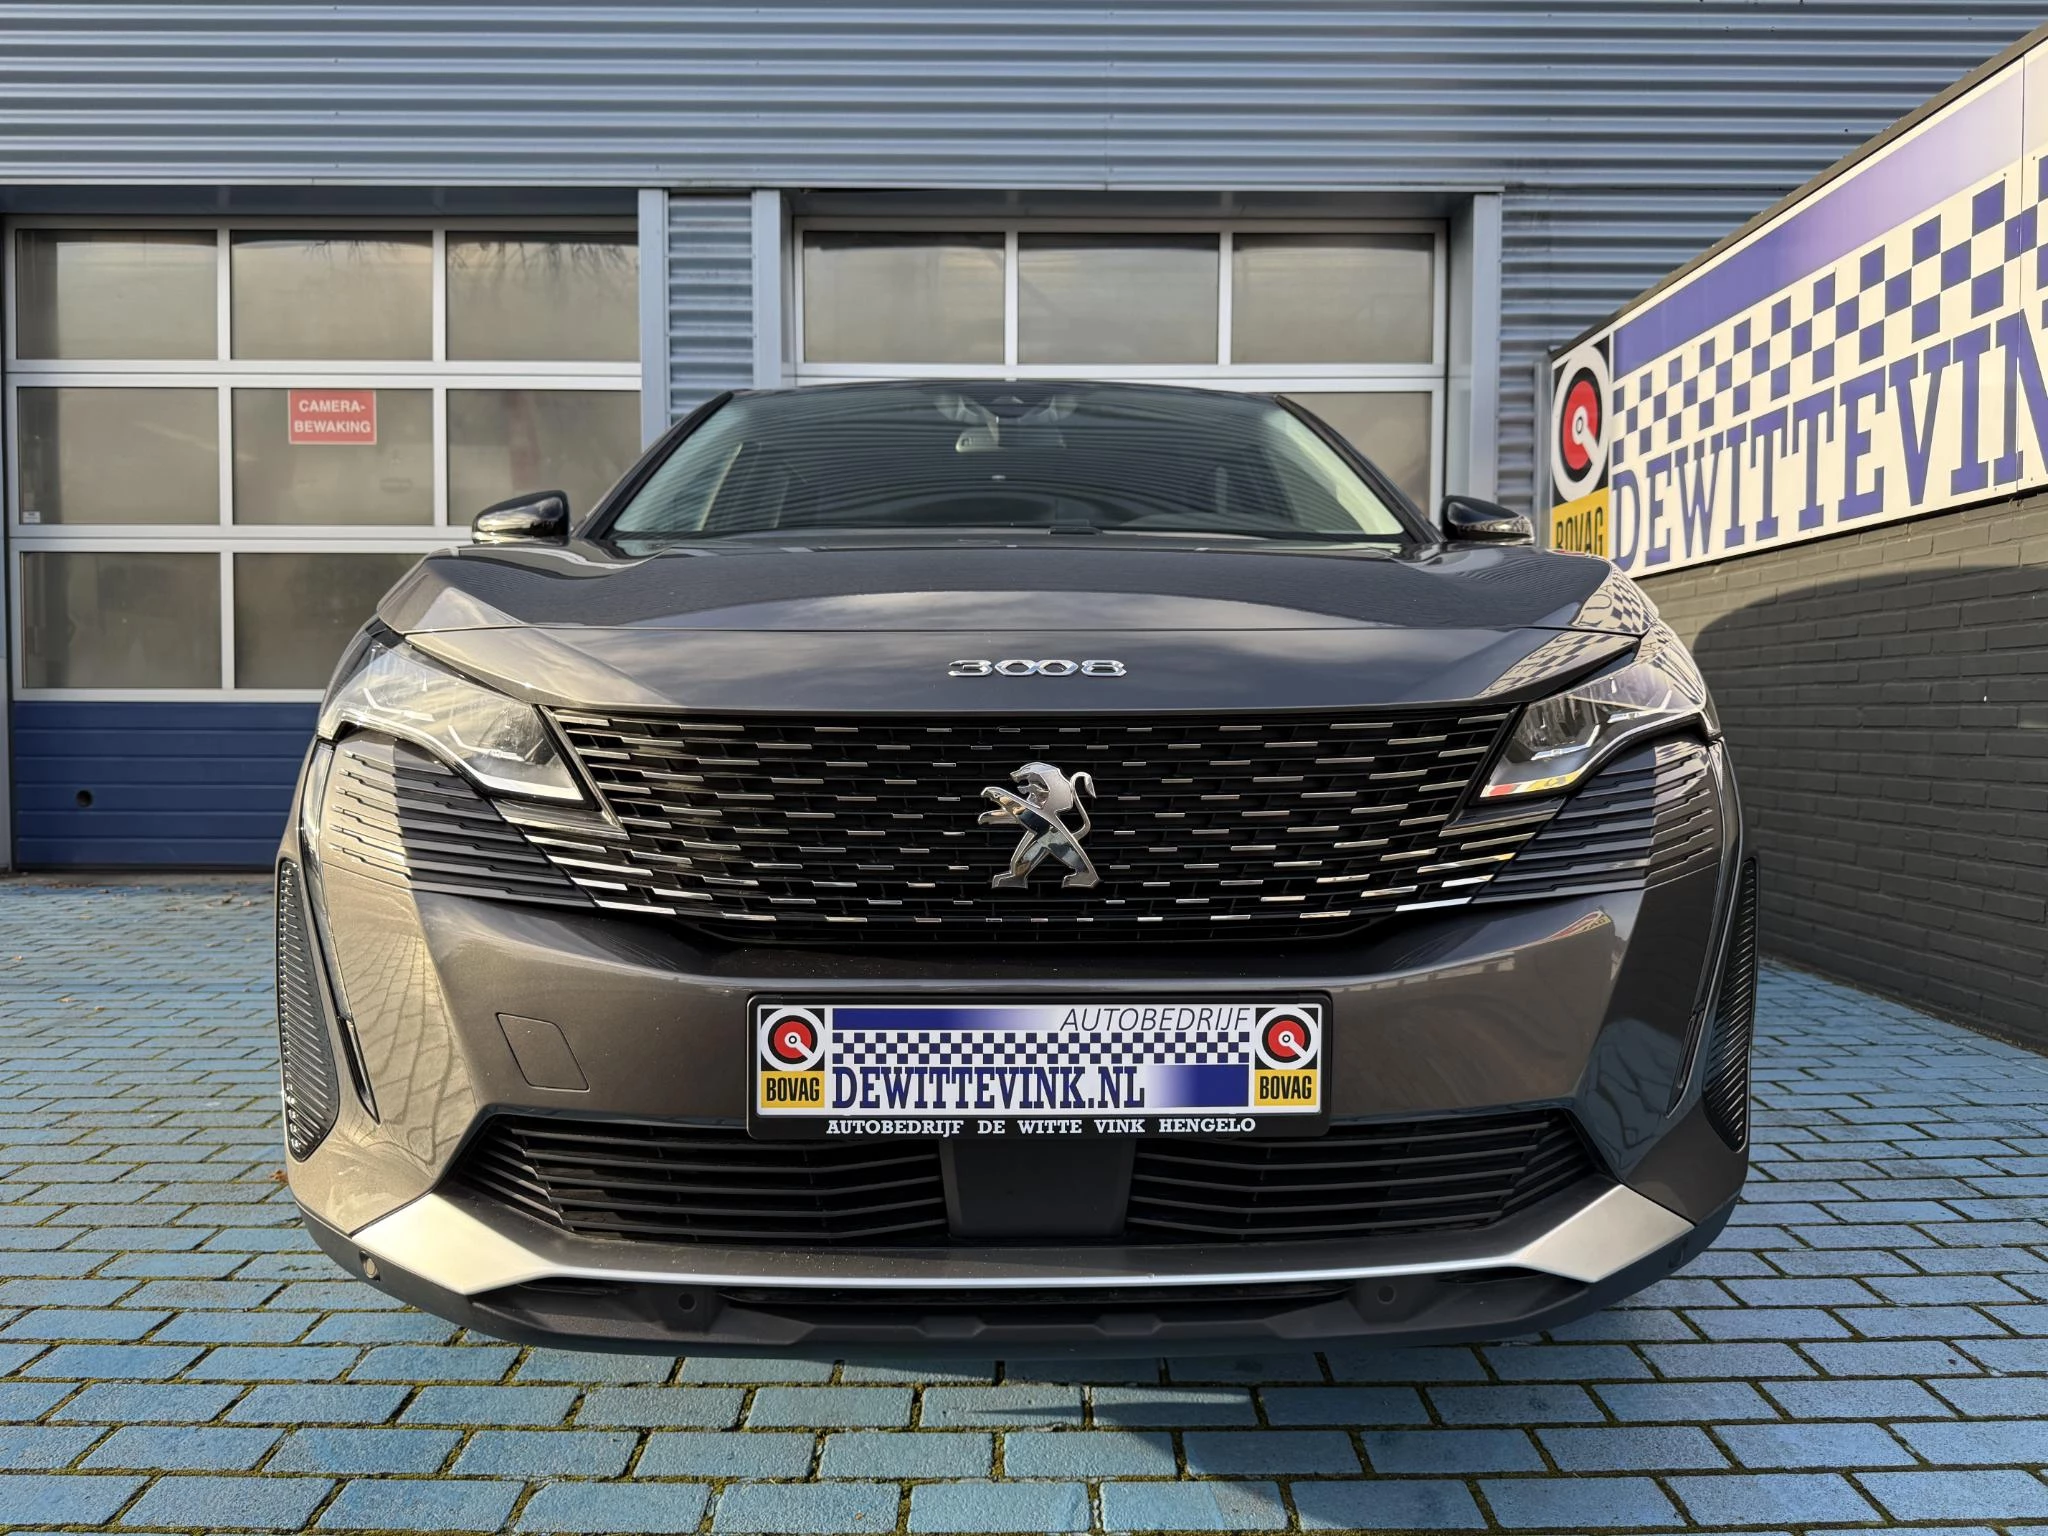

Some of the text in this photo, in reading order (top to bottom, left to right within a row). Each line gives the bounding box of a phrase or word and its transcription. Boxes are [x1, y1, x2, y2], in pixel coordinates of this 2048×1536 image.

[298, 399, 367, 413] CAMERA-
[294, 420, 372, 434] BEWAKING
[948, 659, 1128, 677] 3008
[1059, 1007, 1250, 1031] AUTOBEDRIJF
[766, 1077, 820, 1102] BOVAG
[832, 1066, 1145, 1109] DEWITTEVINK.NL
[1259, 1075, 1312, 1100] BOVAG
[825, 1117, 1256, 1138] AUTOBEDRIJF DE WITTE VINK HENGELO
